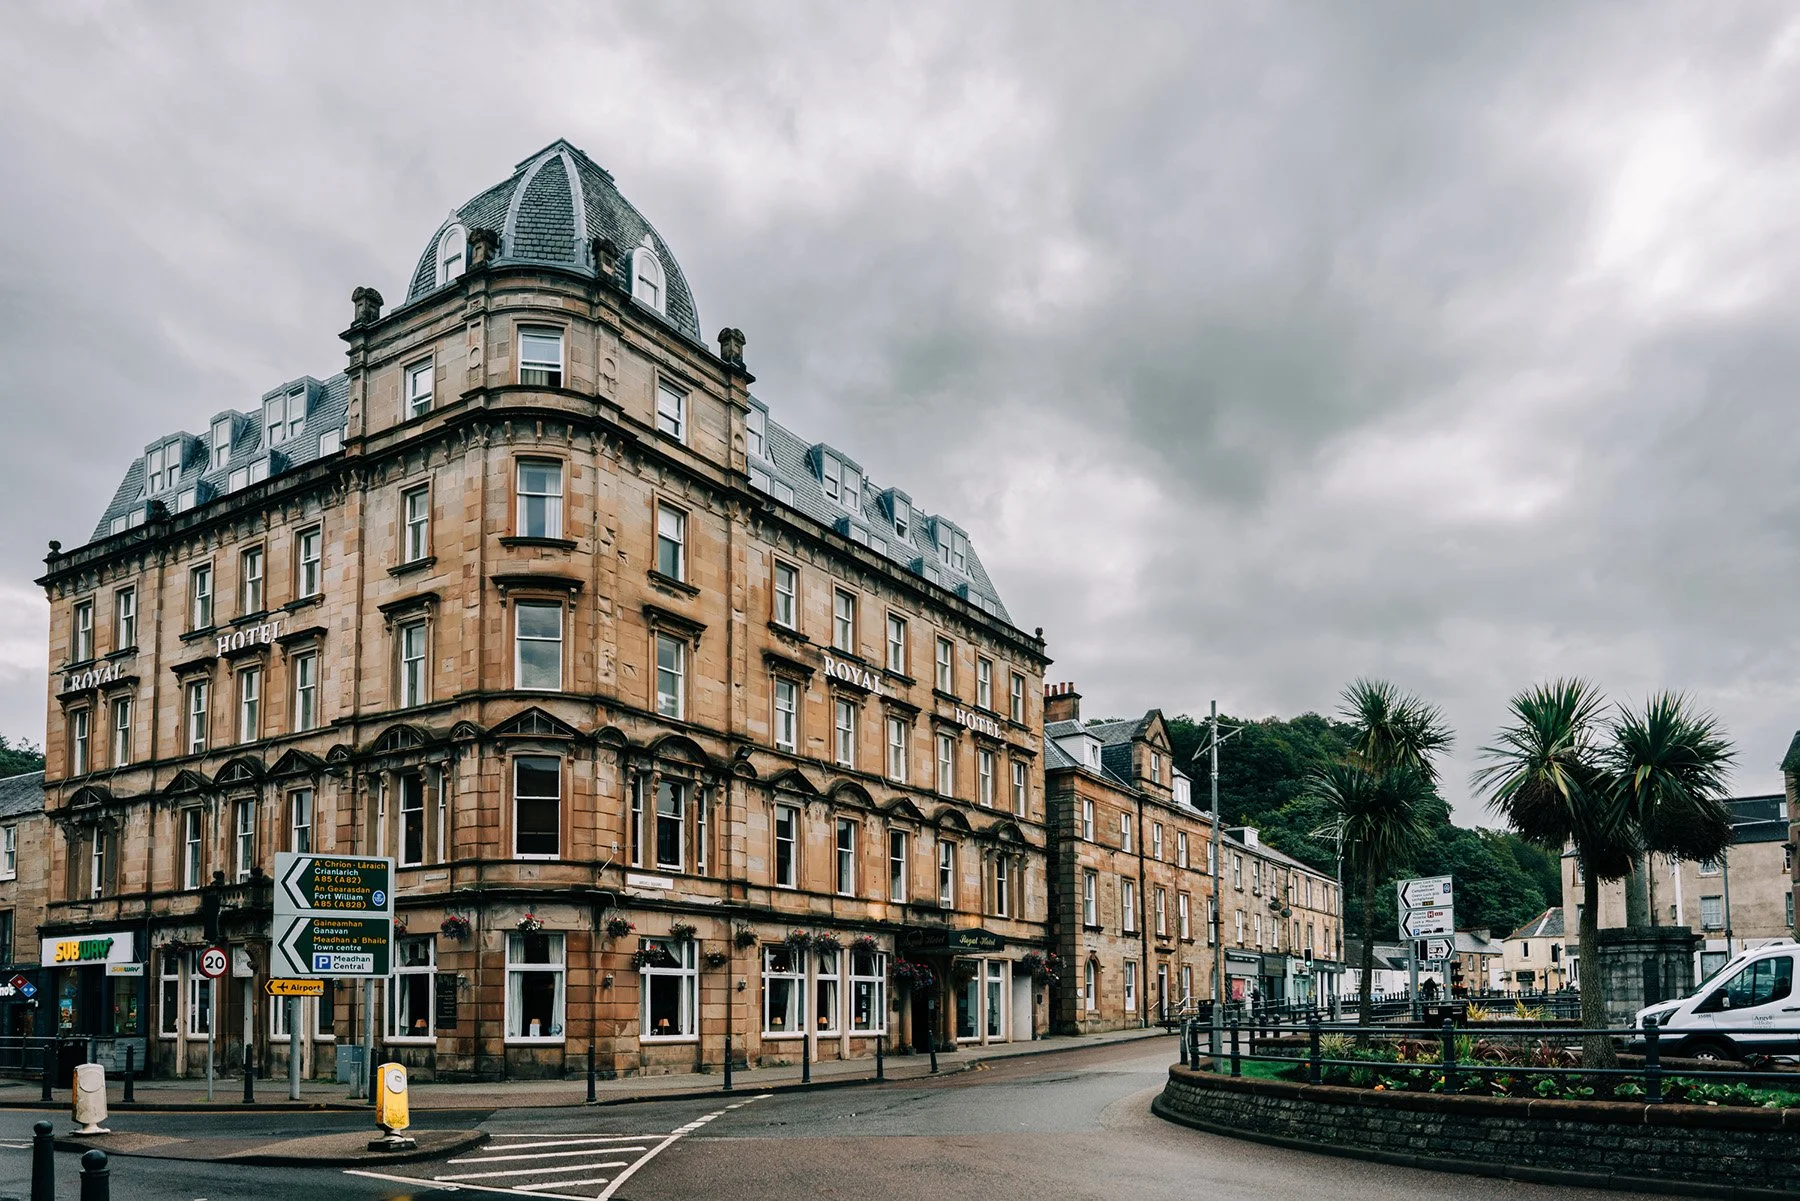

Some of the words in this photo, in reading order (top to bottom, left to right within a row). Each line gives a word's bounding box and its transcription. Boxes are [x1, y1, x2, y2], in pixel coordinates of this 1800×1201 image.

[216, 621, 284, 658] HOTEL
[71, 662, 123, 692] ROYAL
[824, 655, 884, 695] ROYAL
[955, 707, 1002, 739] HOTEL
[324, 860, 352, 868] Chrion
[314, 868, 359, 876] Crianlarich
[334, 876, 362, 884] (A82)
[327, 885, 371, 893] Gearasdan
[314, 892, 332, 900] Fort
[333, 893, 364, 901] William
[334, 901, 367, 909] (A828)
[313, 919, 363, 927] Gaineamhan
[959, 934, 979, 946] Royal
[980, 937, 996, 946] Hotel
[54, 937, 114, 962] SUBWAY
[205, 956, 225, 969] 20
[290, 984, 321, 992] Airport
